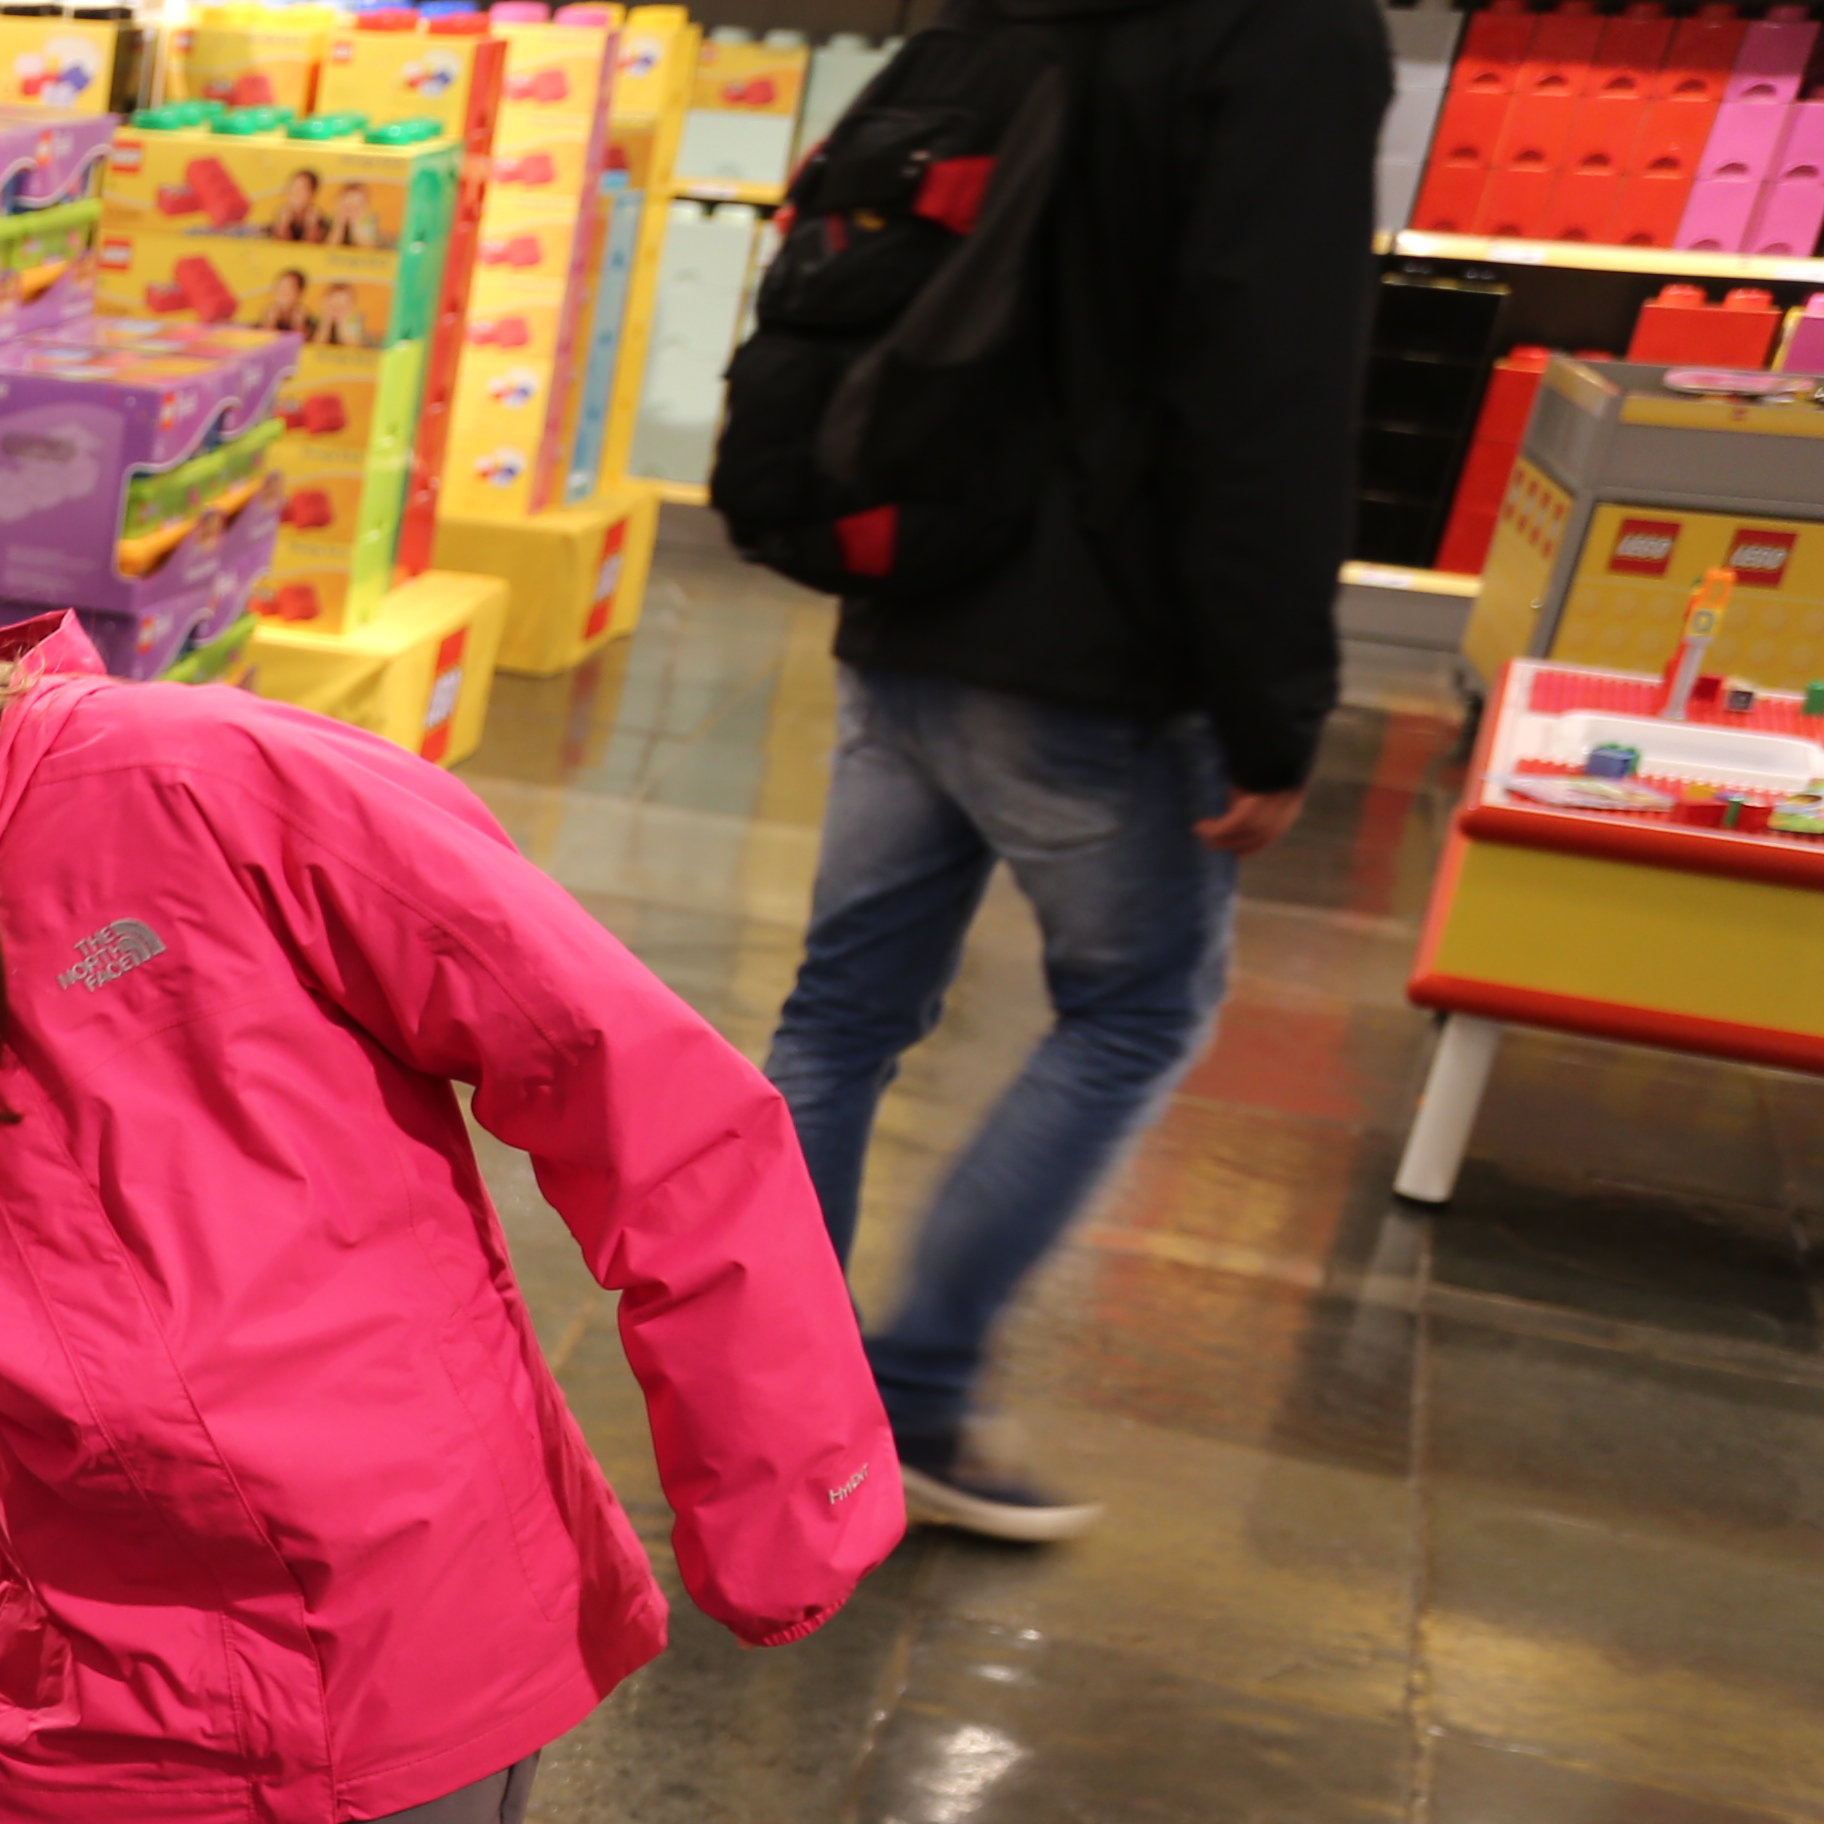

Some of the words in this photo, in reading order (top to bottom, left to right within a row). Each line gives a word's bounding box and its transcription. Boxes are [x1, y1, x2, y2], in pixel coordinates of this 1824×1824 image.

[74, 925, 115, 957] THE
[57, 946, 121, 991] NORTH
[84, 953, 135, 993] FACE
